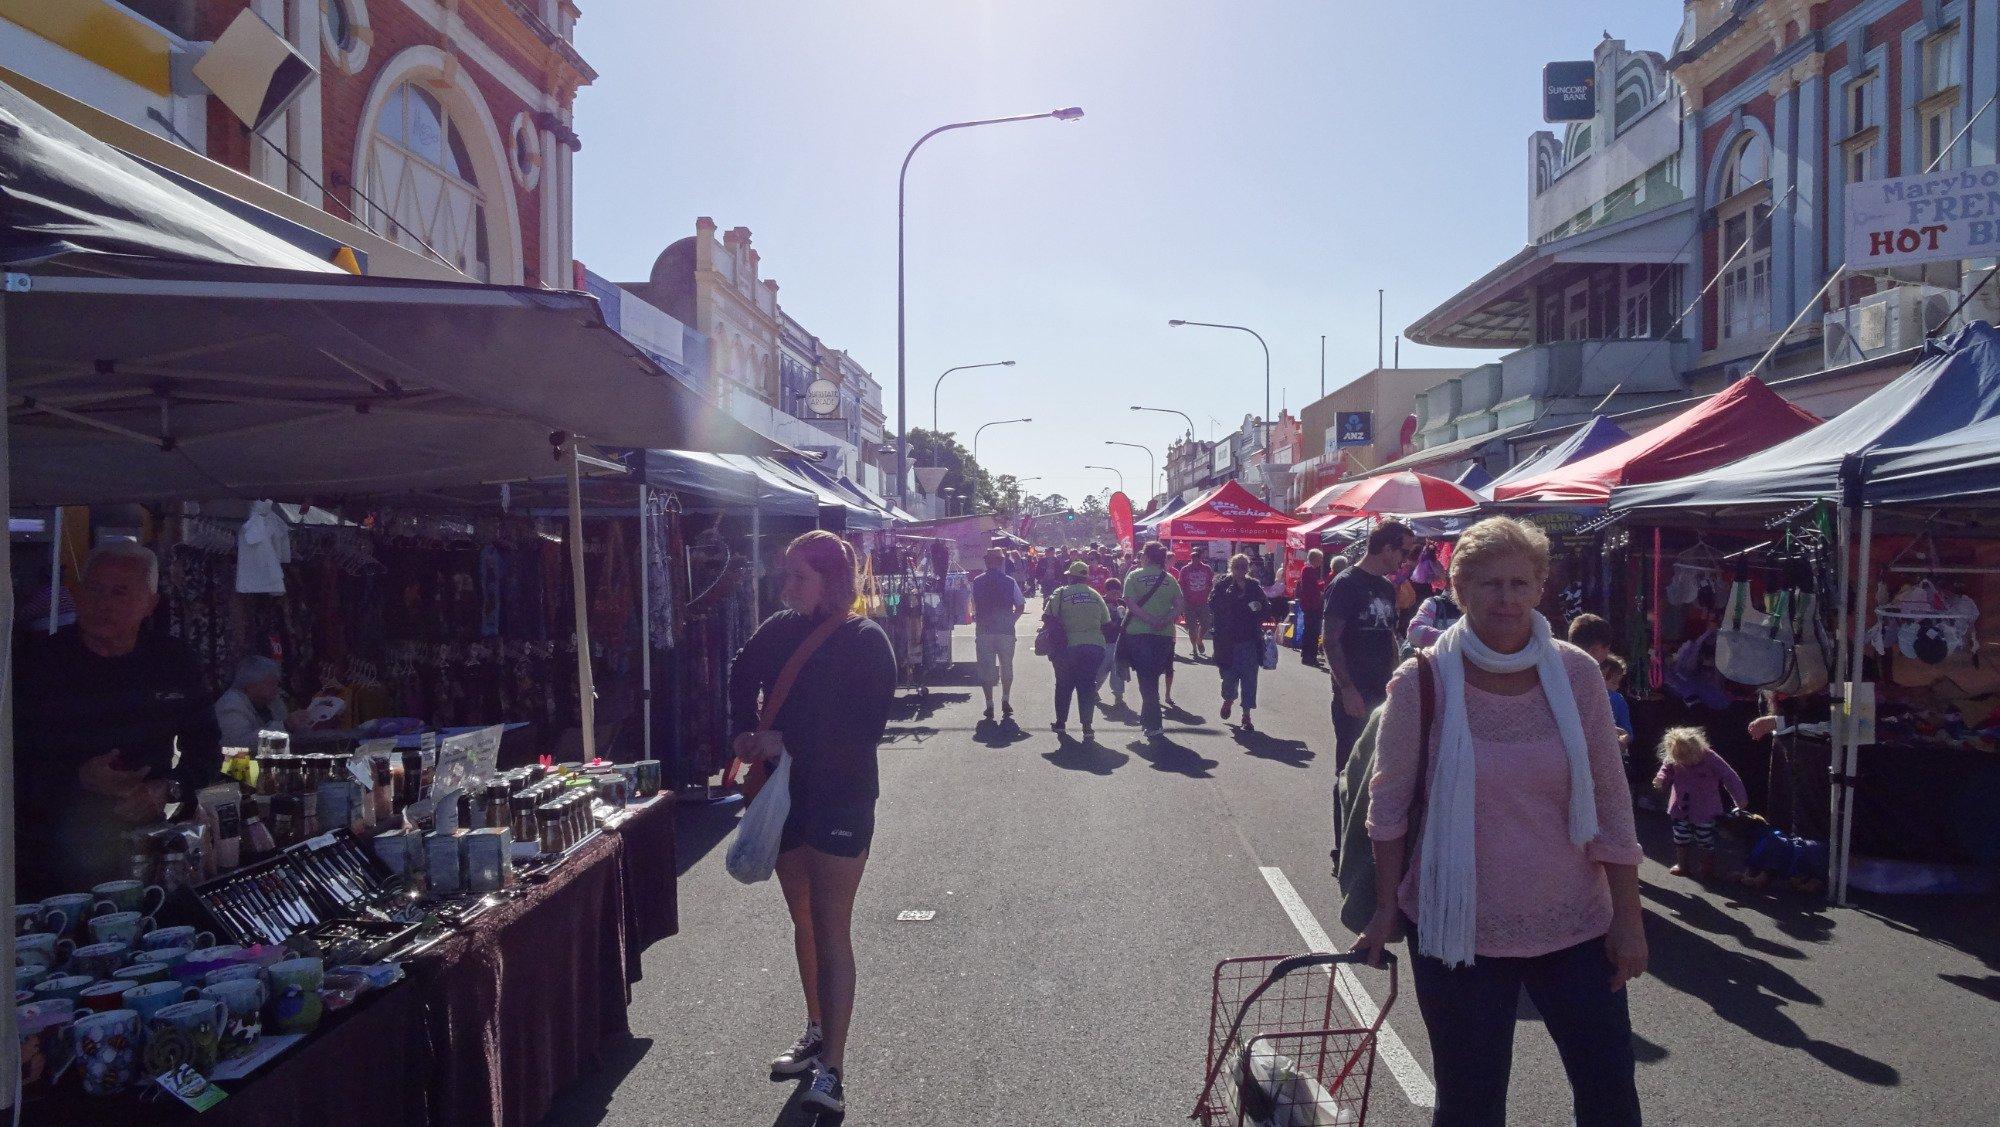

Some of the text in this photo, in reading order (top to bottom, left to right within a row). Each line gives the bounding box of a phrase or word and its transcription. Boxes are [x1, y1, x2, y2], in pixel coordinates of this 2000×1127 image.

[1548, 85, 1587, 94] SUNCORP
[1868, 224, 1949, 256] HOT
[1342, 432, 1365, 440] ANZ
